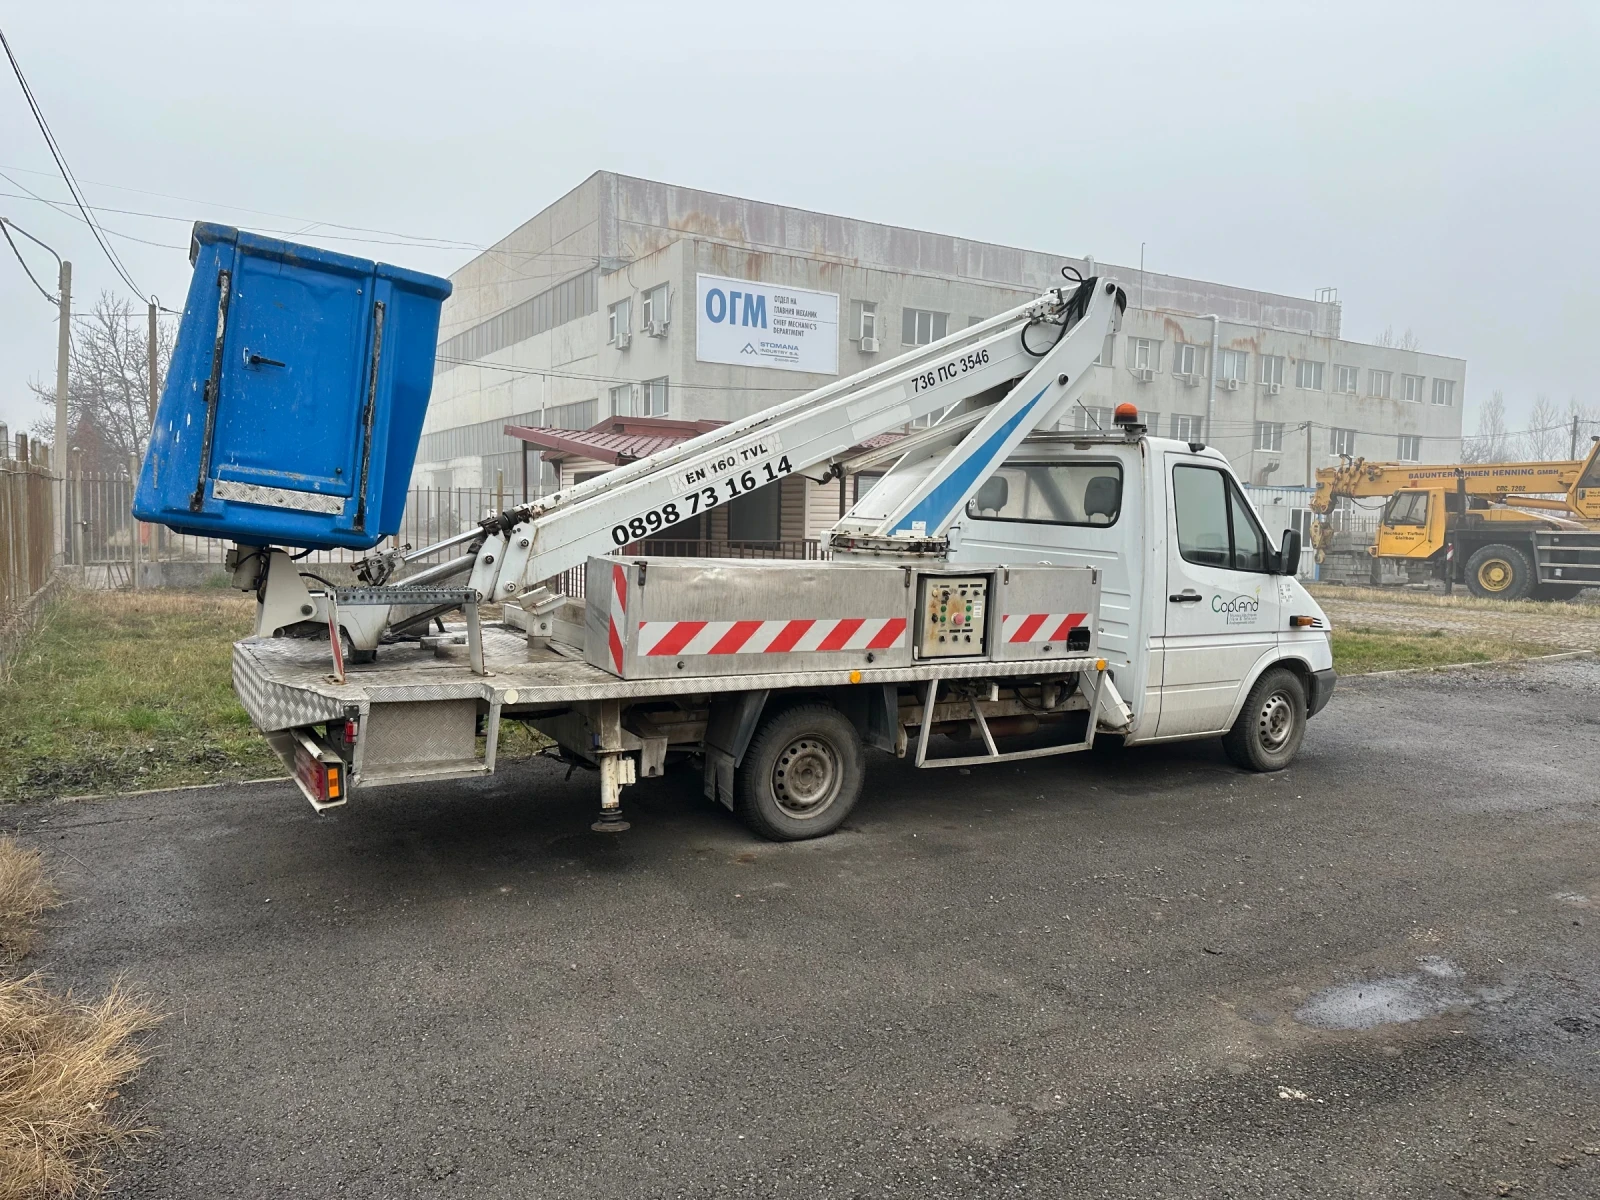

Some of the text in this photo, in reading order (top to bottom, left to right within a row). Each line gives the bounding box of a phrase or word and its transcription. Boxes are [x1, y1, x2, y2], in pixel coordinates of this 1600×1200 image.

[774, 295, 797, 305] ОТДЕЛ НА
[706, 288, 767, 329] ОГМ
[774, 305, 817, 319] ГЛАВНИЯ МЕХАНИК
[773, 319, 817, 331] CHIEF MECHANIC'S
[773, 326, 804, 337] DEPARTMENT
[760, 341, 799, 351] STOMANA
[760, 348, 788, 356] INDUSTRY
[911, 349, 989, 393] 736 ПС 3546
[686, 443, 768, 485] EN 160 TVL
[1408, 470, 1490, 479] BAUUNTERNHMEN
[1492, 468, 1534, 476] HENNING
[611, 455, 793, 546] 0898 73 16 14
